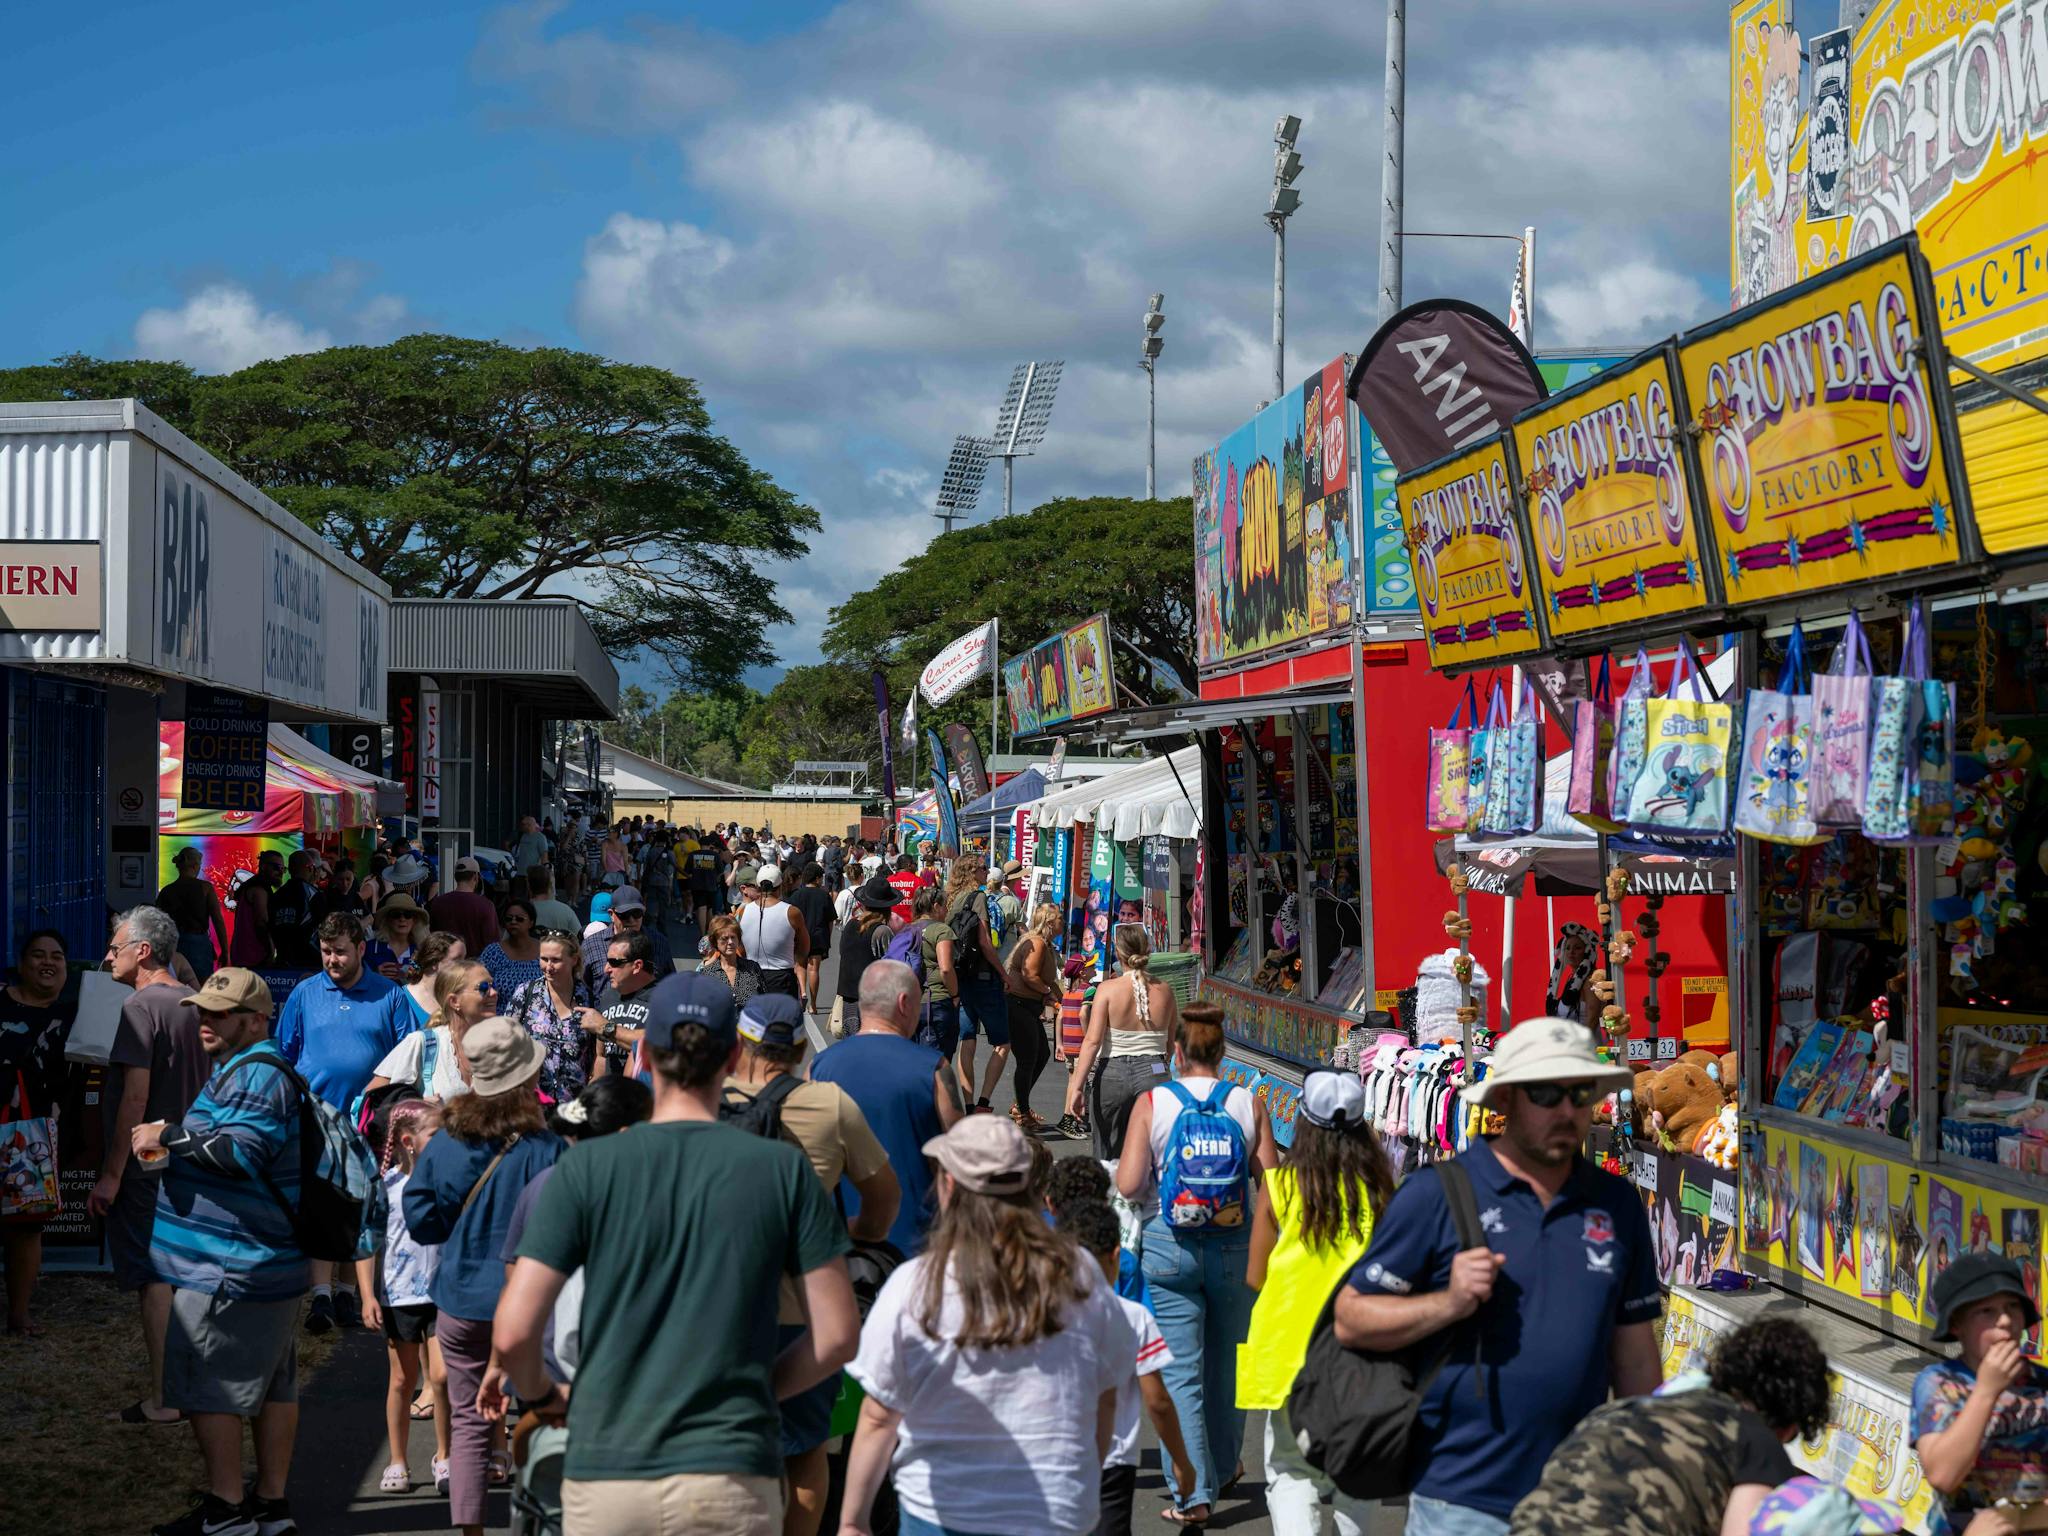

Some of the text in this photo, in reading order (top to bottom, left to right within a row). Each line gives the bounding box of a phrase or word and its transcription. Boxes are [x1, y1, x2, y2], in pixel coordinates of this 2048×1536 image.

[1706, 282, 1931, 533] SHOWBAG
[1532, 379, 1686, 577] SHOWBAG
[1241, 454, 1280, 597] JUMBO
[1411, 459, 1523, 618] SHOWBAG
[161, 470, 211, 666] BAR
[303, 567, 320, 625] CLUB
[359, 595, 379, 712] BAR
[925, 637, 988, 685] Cairns Sho
[213, 696, 244, 708] Rotary
[189, 717, 263, 733] COLD DRINKS
[187, 735, 262, 762] COFFEE
[187, 762, 261, 778] ENERGY DRINKS
[186, 779, 260, 807] BEER
[264, 976, 297, 987] Rotary
[1630, 1041, 1674, 1056] 32 32
[80, 1170, 96, 1179] THE
[1712, 1189, 1737, 1219] ANIMAL
